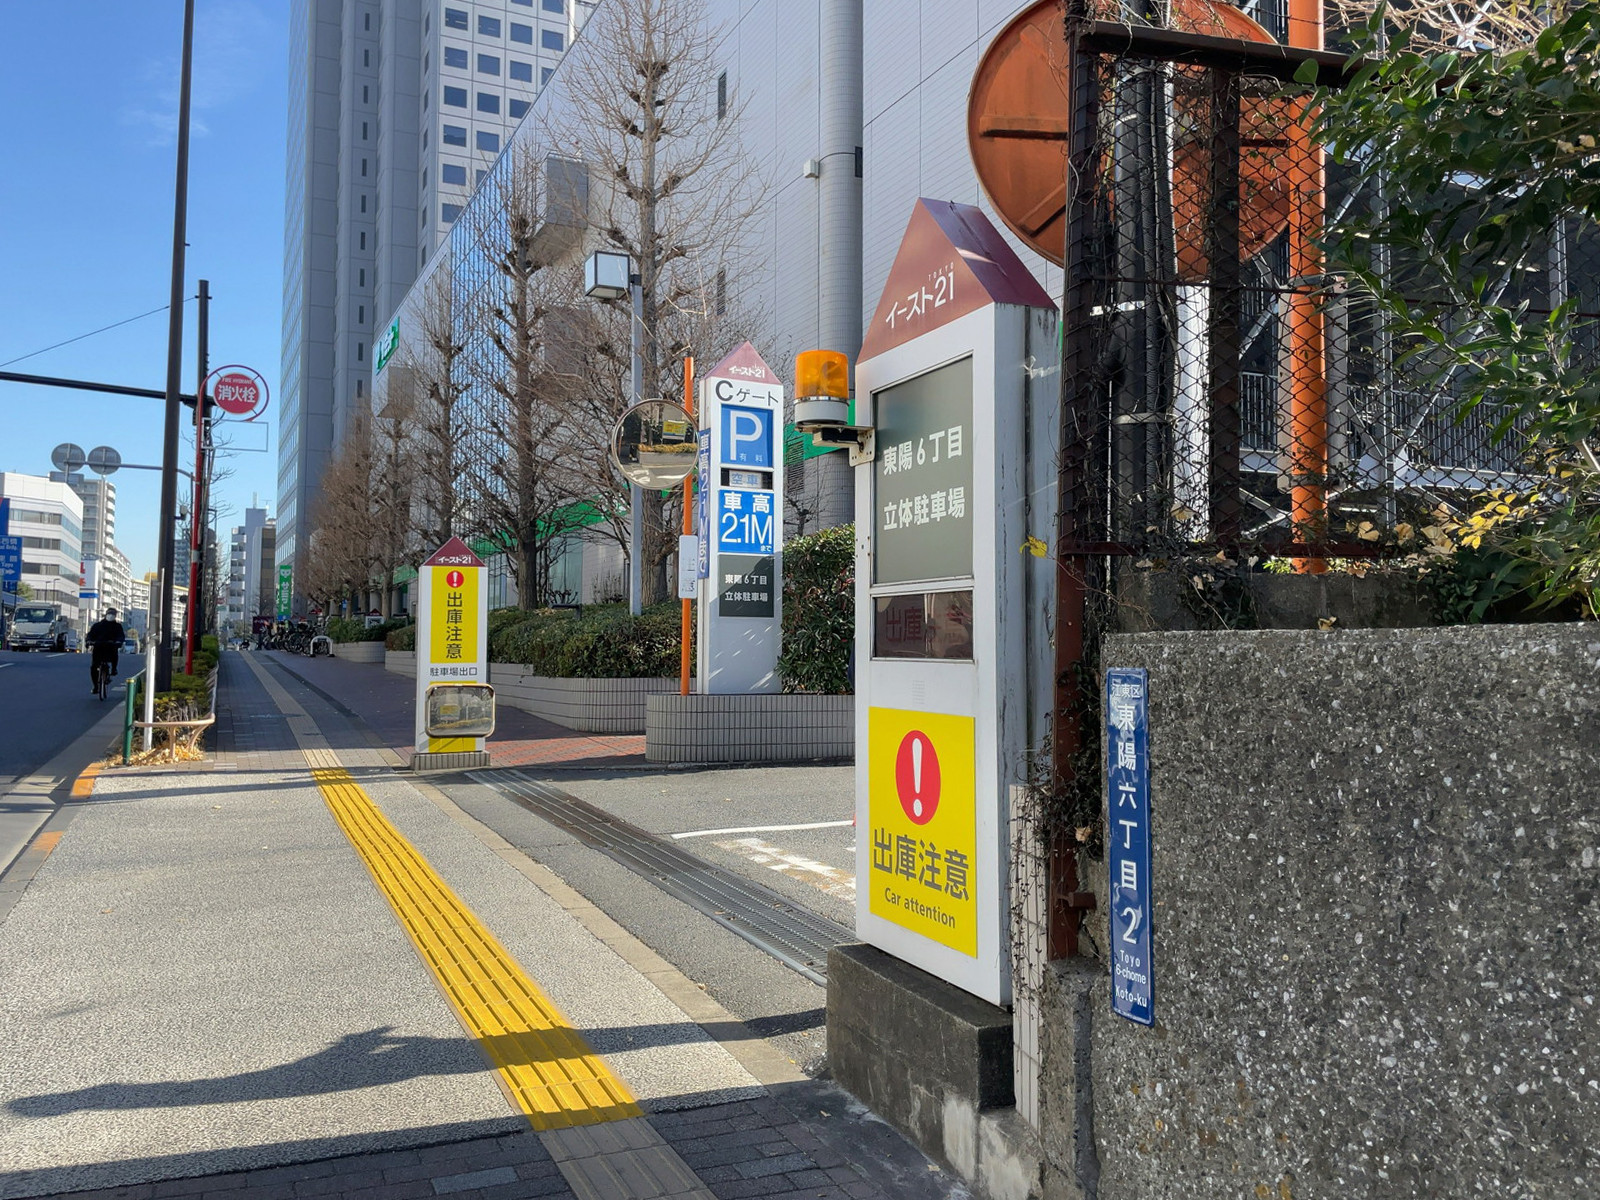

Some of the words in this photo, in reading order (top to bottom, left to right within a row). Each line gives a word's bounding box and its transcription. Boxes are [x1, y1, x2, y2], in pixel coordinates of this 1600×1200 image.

[885, 271, 954, 329] イースト21
[729, 365, 765, 379] イースト21
[218, 385, 256, 402] 消火栓
[715, 380, 779, 406] Cゲート
[730, 410, 763, 461] P
[883, 425, 963, 476] 東陽6丁目
[723, 491, 771, 514] 車高
[883, 486, 966, 531] 立体駐車場
[438, 556, 472, 565] イースト21
[724, 591, 768, 602] 立体駐車場
[445, 592, 462, 659] 出庫注意
[430, 667, 477, 676] 駐車場出口
[1112, 684, 1141, 698] 江東区
[873, 827, 970, 902] 出庫注意
[884, 887, 901, 907] Car
[904, 897, 956, 929] attention
[1119, 950, 1141, 968] Toyo
[1115, 963, 1147, 985] 6-chome
[1115, 983, 1148, 1008] Koto-ku
